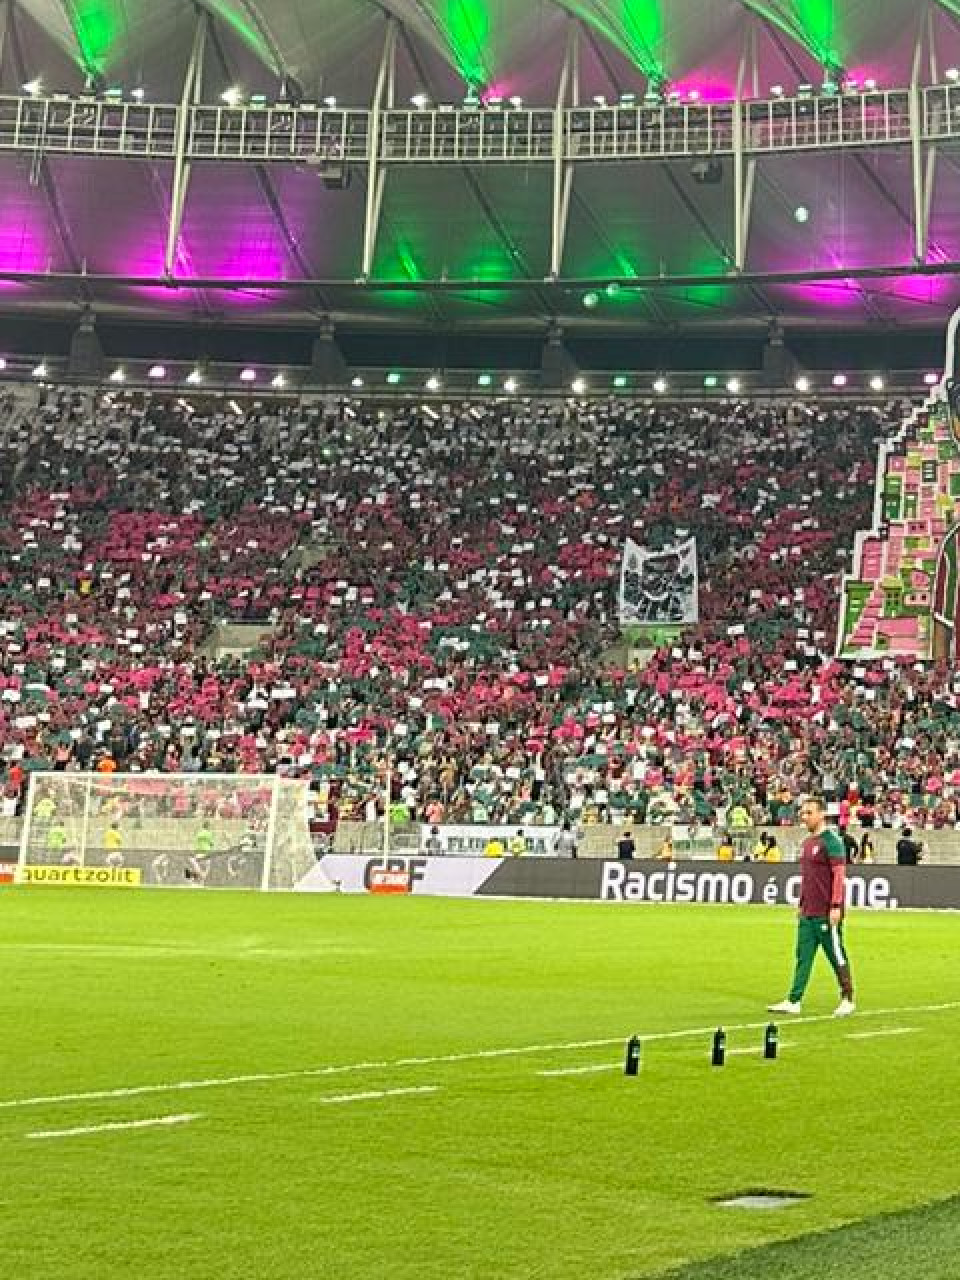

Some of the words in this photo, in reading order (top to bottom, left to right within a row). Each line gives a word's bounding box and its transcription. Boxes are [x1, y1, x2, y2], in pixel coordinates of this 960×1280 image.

[602, 861, 754, 902] Racismo
[763, 876, 778, 904] é
[786, 877, 898, 908] cme.
